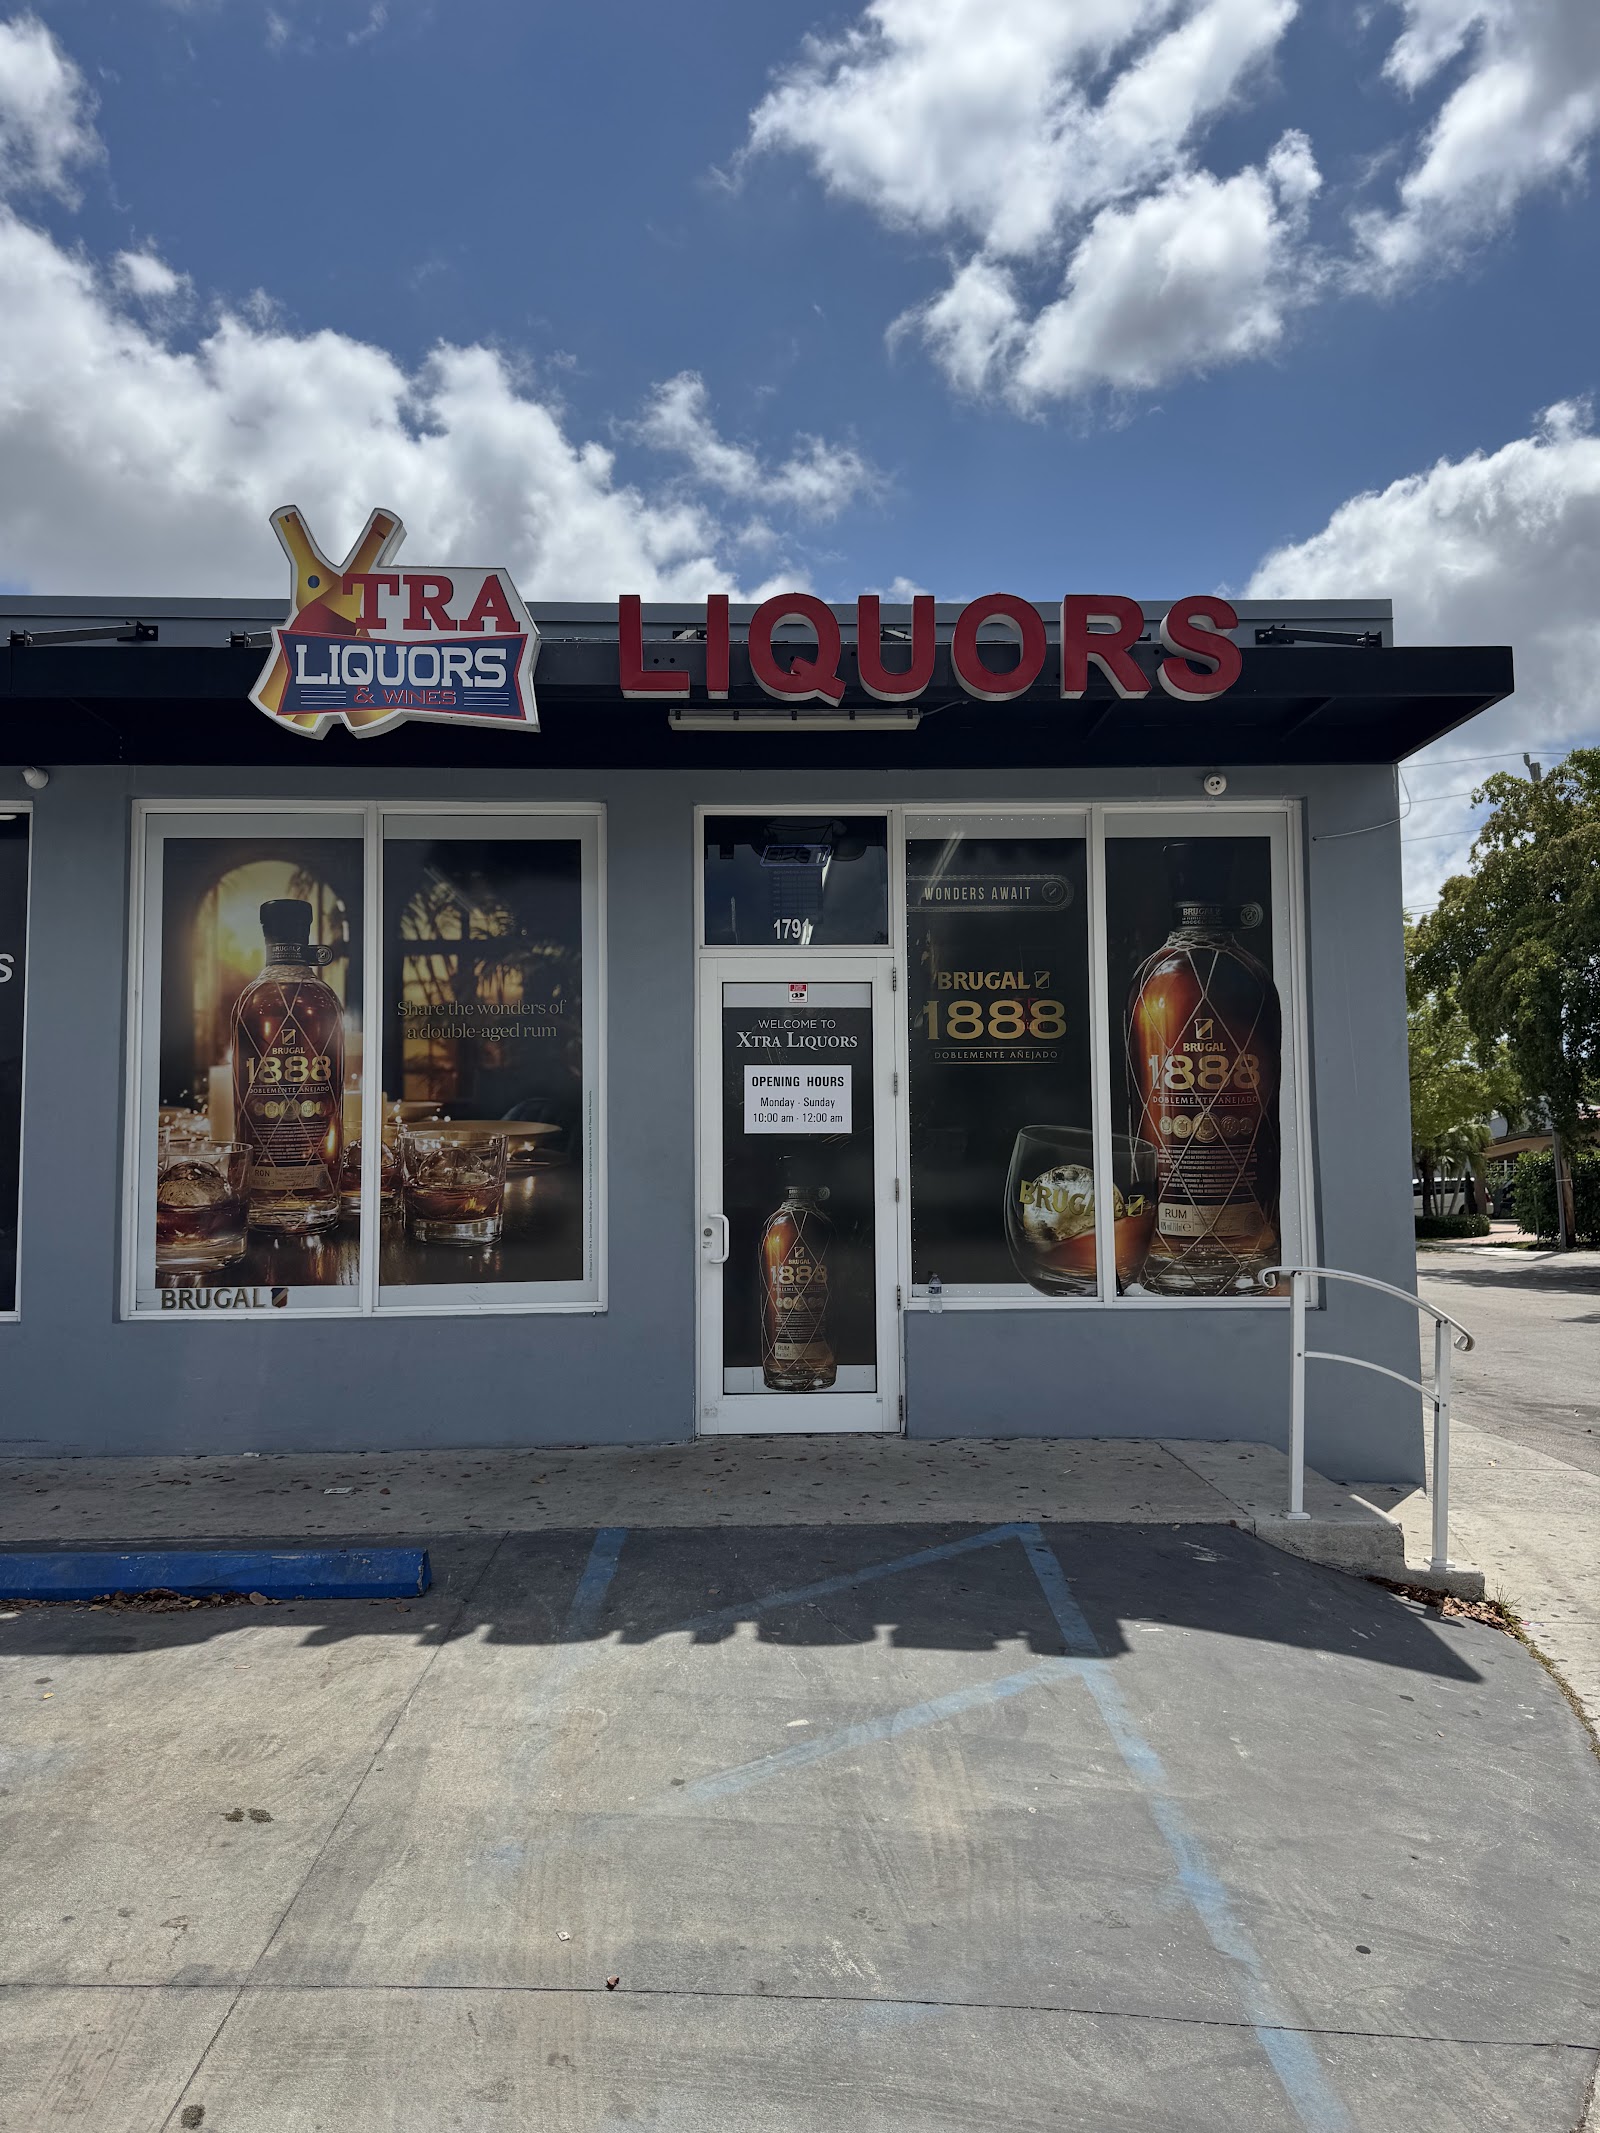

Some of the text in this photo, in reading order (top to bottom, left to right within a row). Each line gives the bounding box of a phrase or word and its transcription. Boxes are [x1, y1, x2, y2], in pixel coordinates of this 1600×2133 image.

[618, 592, 1244, 706] LIQUORS
[295, 644, 507, 688] LIQUORS
[353, 686, 457, 706] & WINES
[924, 886, 1031, 901] WONDERS AWAIT
[773, 918, 810, 940] 1791
[937, 971, 1031, 991] BRUGAL
[397, 999, 567, 1016] Share the wonders of
[758, 1019, 836, 1029] WELCOME TO
[923, 1000, 1067, 1040] 1888
[407, 1024, 557, 1042] a double-aged rum
[272, 1046, 306, 1055] BRUGAL
[934, 1050, 1058, 1060] DOBLEMENTE AÑEJADO
[1182, 1042, 1226, 1052] BRUGAL
[246, 1055, 332, 1084] 1888
[1148, 1054, 1261, 1090] 1888
[249, 1084, 330, 1094] DOBLEMENTE AÑEJADO
[751, 1076, 844, 1087] OPENING HOURS
[760, 1097, 795, 1109] Monday
[803, 1097, 836, 1109] Sunday
[1152, 1094, 1259, 1105] DOBLEMENTE AÑEJADO
[753, 1112, 778, 1123] 10:00
[781, 1115, 794, 1123] am
[802, 1112, 828, 1123] 12:00
[830, 1115, 843, 1123] am
[254, 1169, 271, 1178] RON
[1164, 1208, 1188, 1220] RUM
[770, 1265, 828, 1285] 1888
[160, 1288, 266, 1311] BRUGAL
